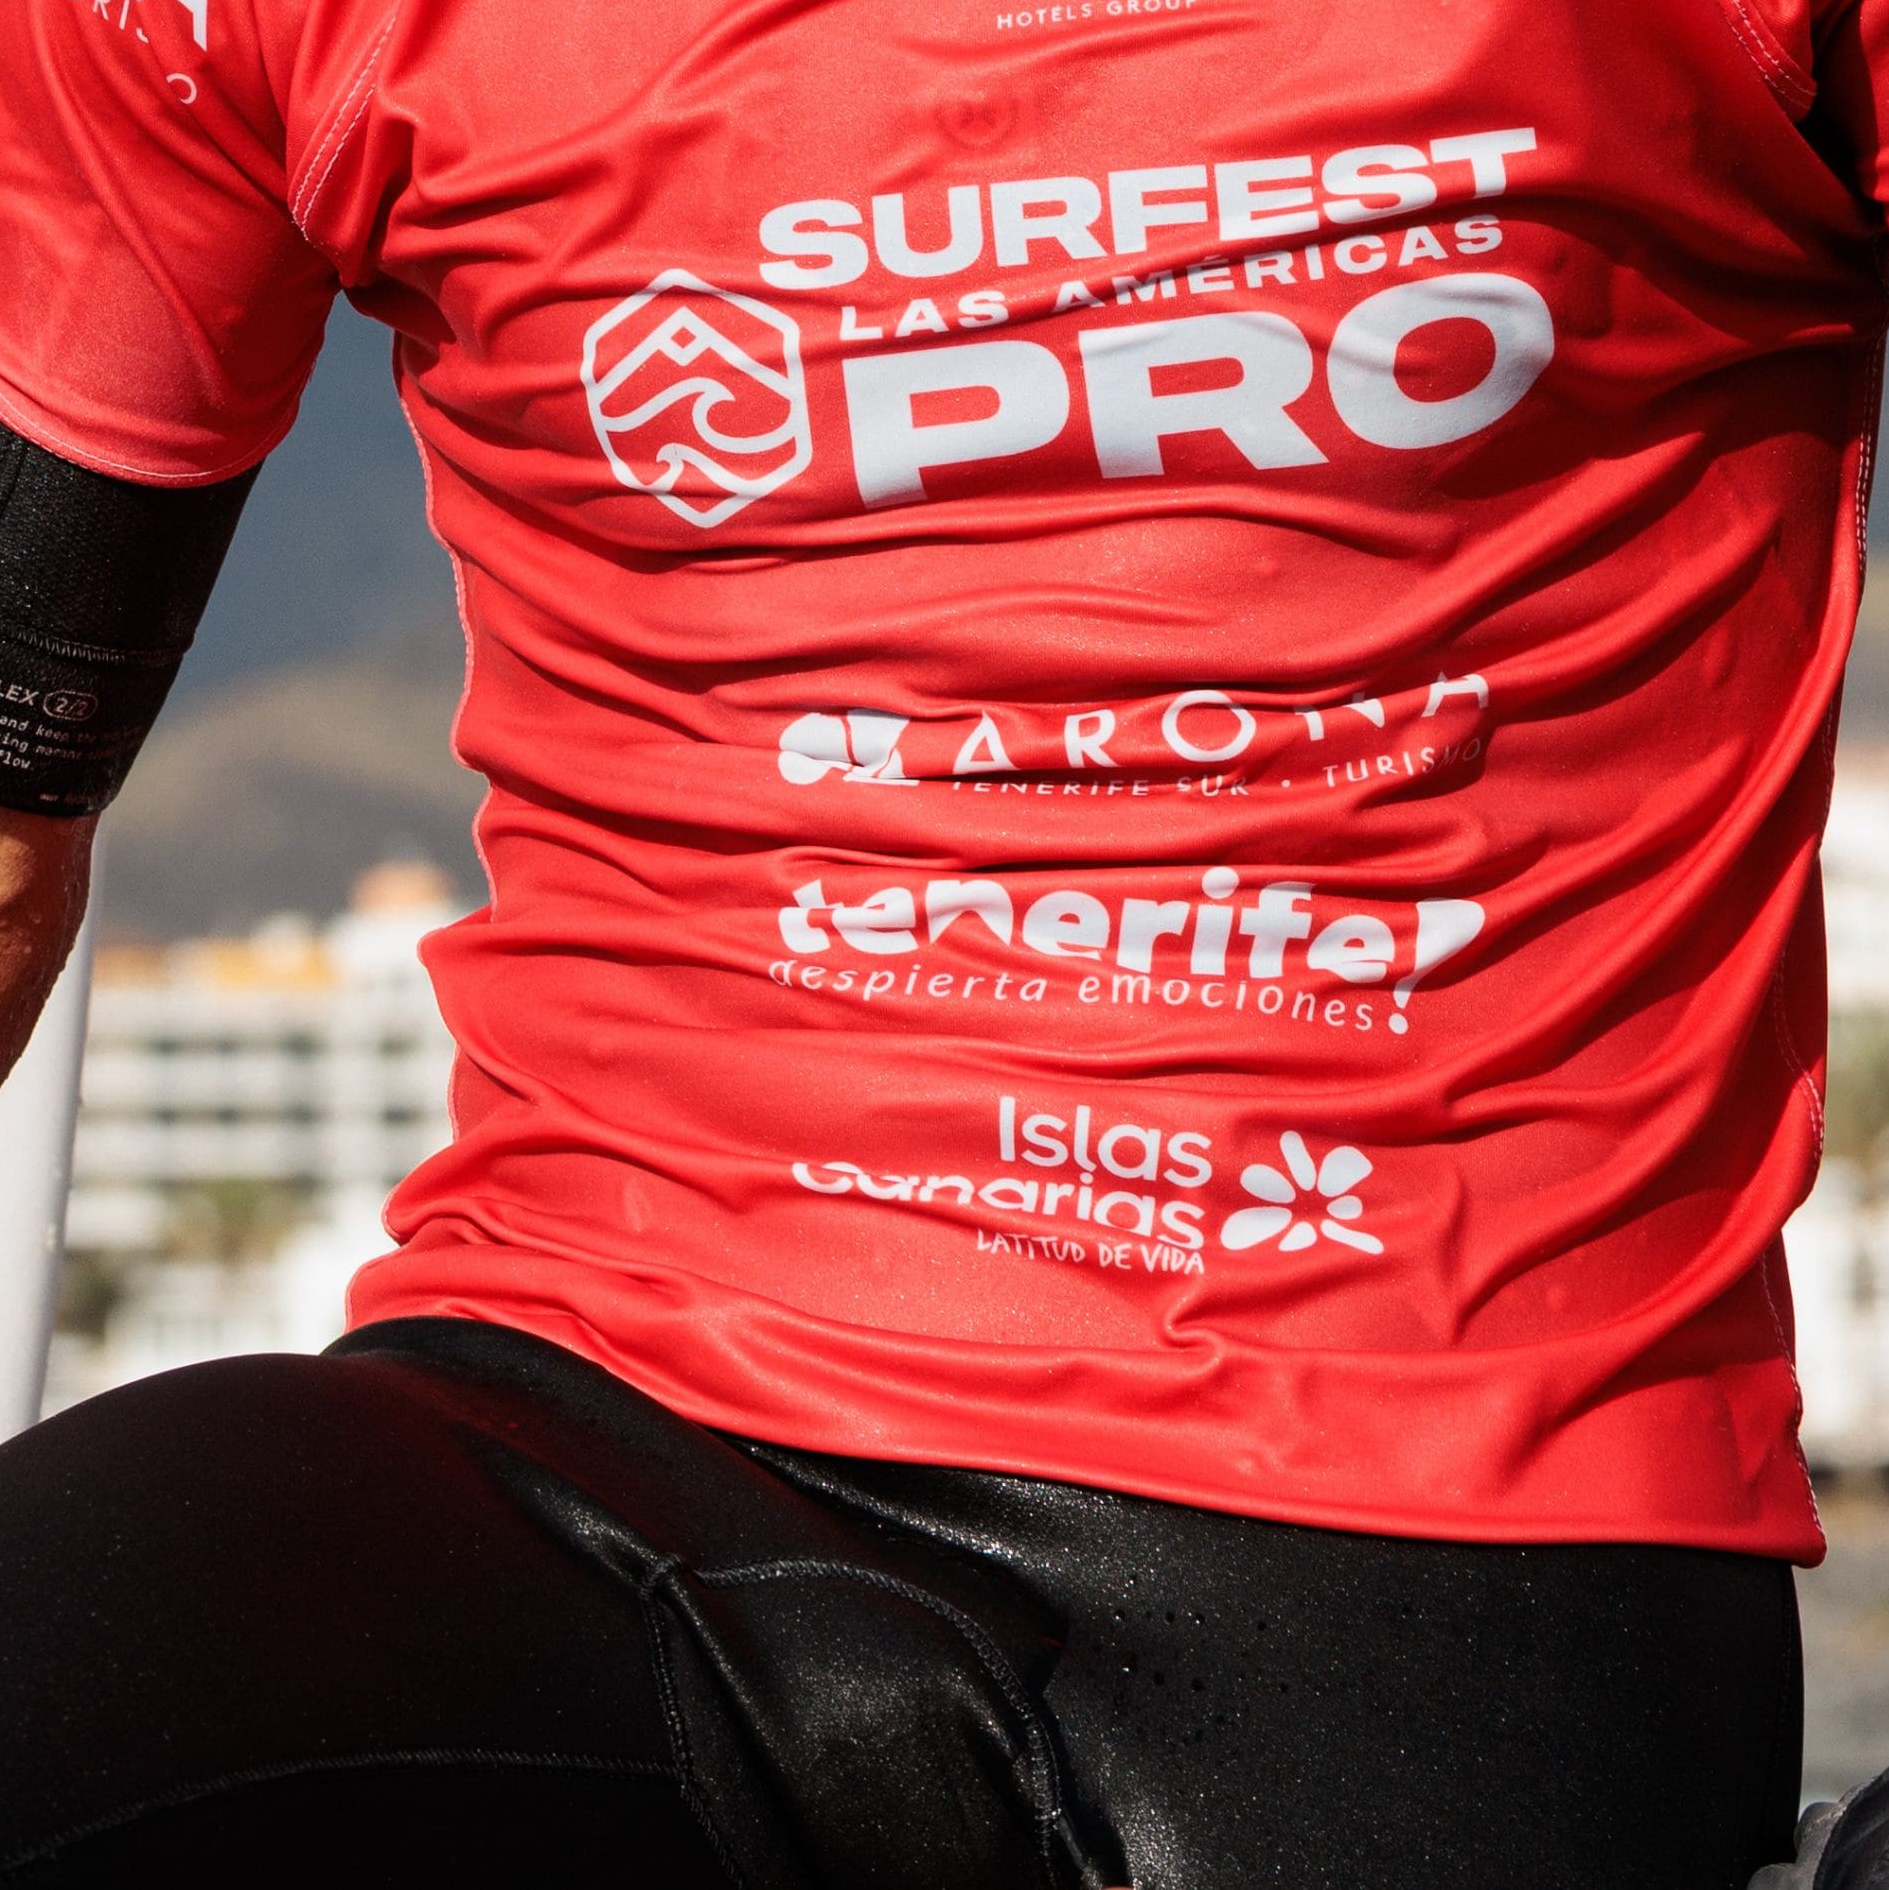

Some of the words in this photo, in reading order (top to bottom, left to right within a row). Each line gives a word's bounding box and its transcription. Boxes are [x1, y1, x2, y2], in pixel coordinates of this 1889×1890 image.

[996, 2, 1094, 30] HOTELS
[759, 127, 1538, 291] SURFEST
[839, 289, 1009, 341] LAS
[1052, 213, 1505, 310] AMÉRICAS
[840, 271, 1556, 510] PRO
[0, 714, 30, 732] and
[767, 958, 1049, 1002] despierta
[1077, 972, 1374, 1032] emociones
[998, 1095, 1212, 1188] Islas
[977, 1228, 1086, 1264] LATITUD
[1098, 1240, 1132, 1270] DE
[1140, 1241, 1205, 1275] VIDA
